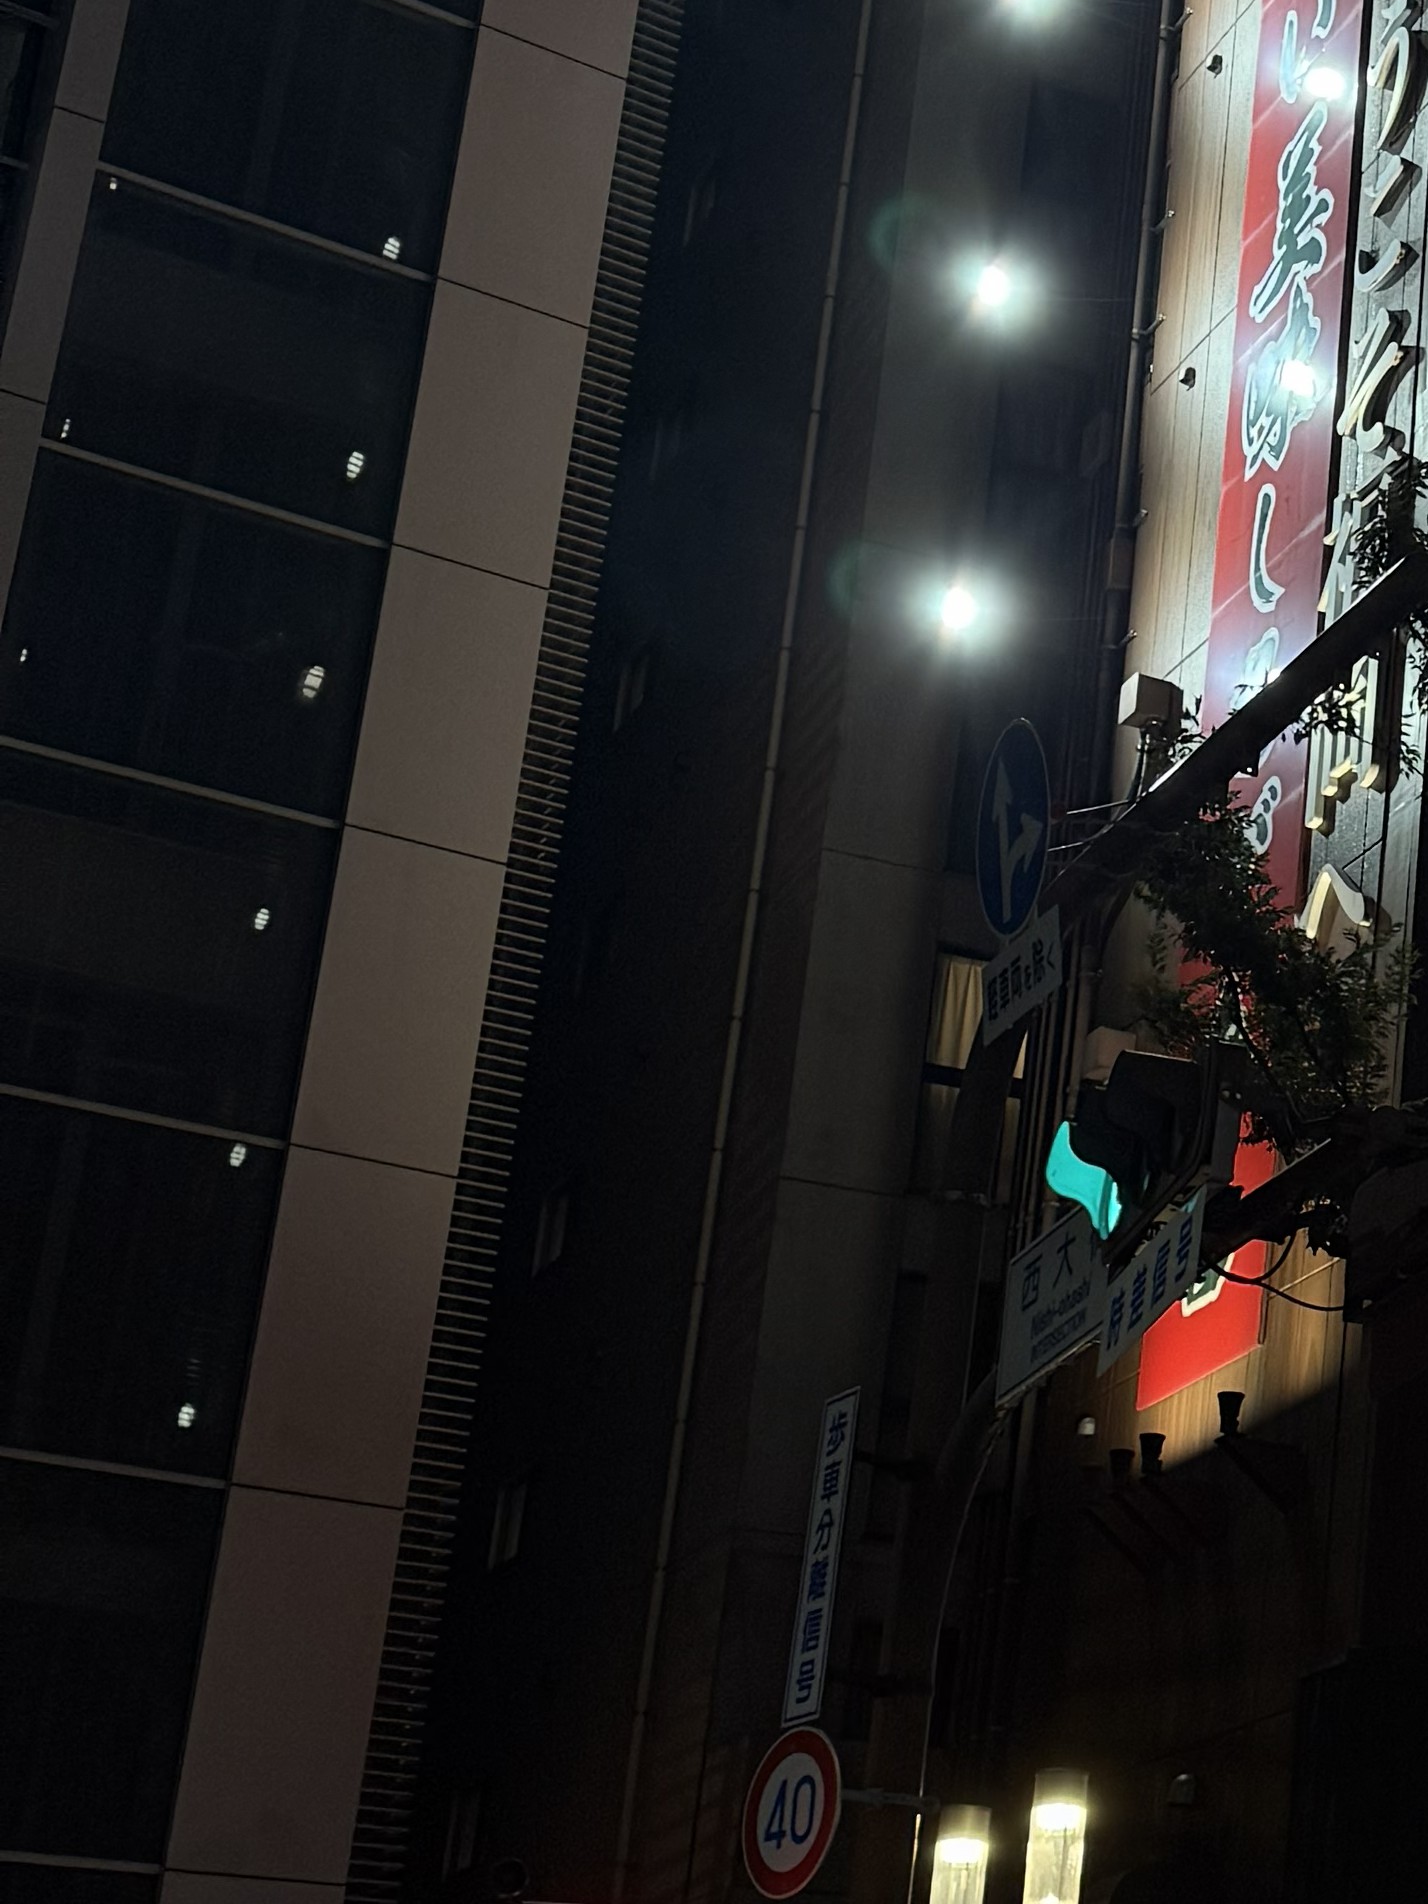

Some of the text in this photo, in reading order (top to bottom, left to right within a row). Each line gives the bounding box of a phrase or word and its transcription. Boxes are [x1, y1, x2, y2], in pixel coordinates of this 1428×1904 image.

[1021, 1230, 1099, 1312] 西大
[791, 1408, 852, 1708] 歩車分離信号
[762, 1772, 819, 1853] 40
